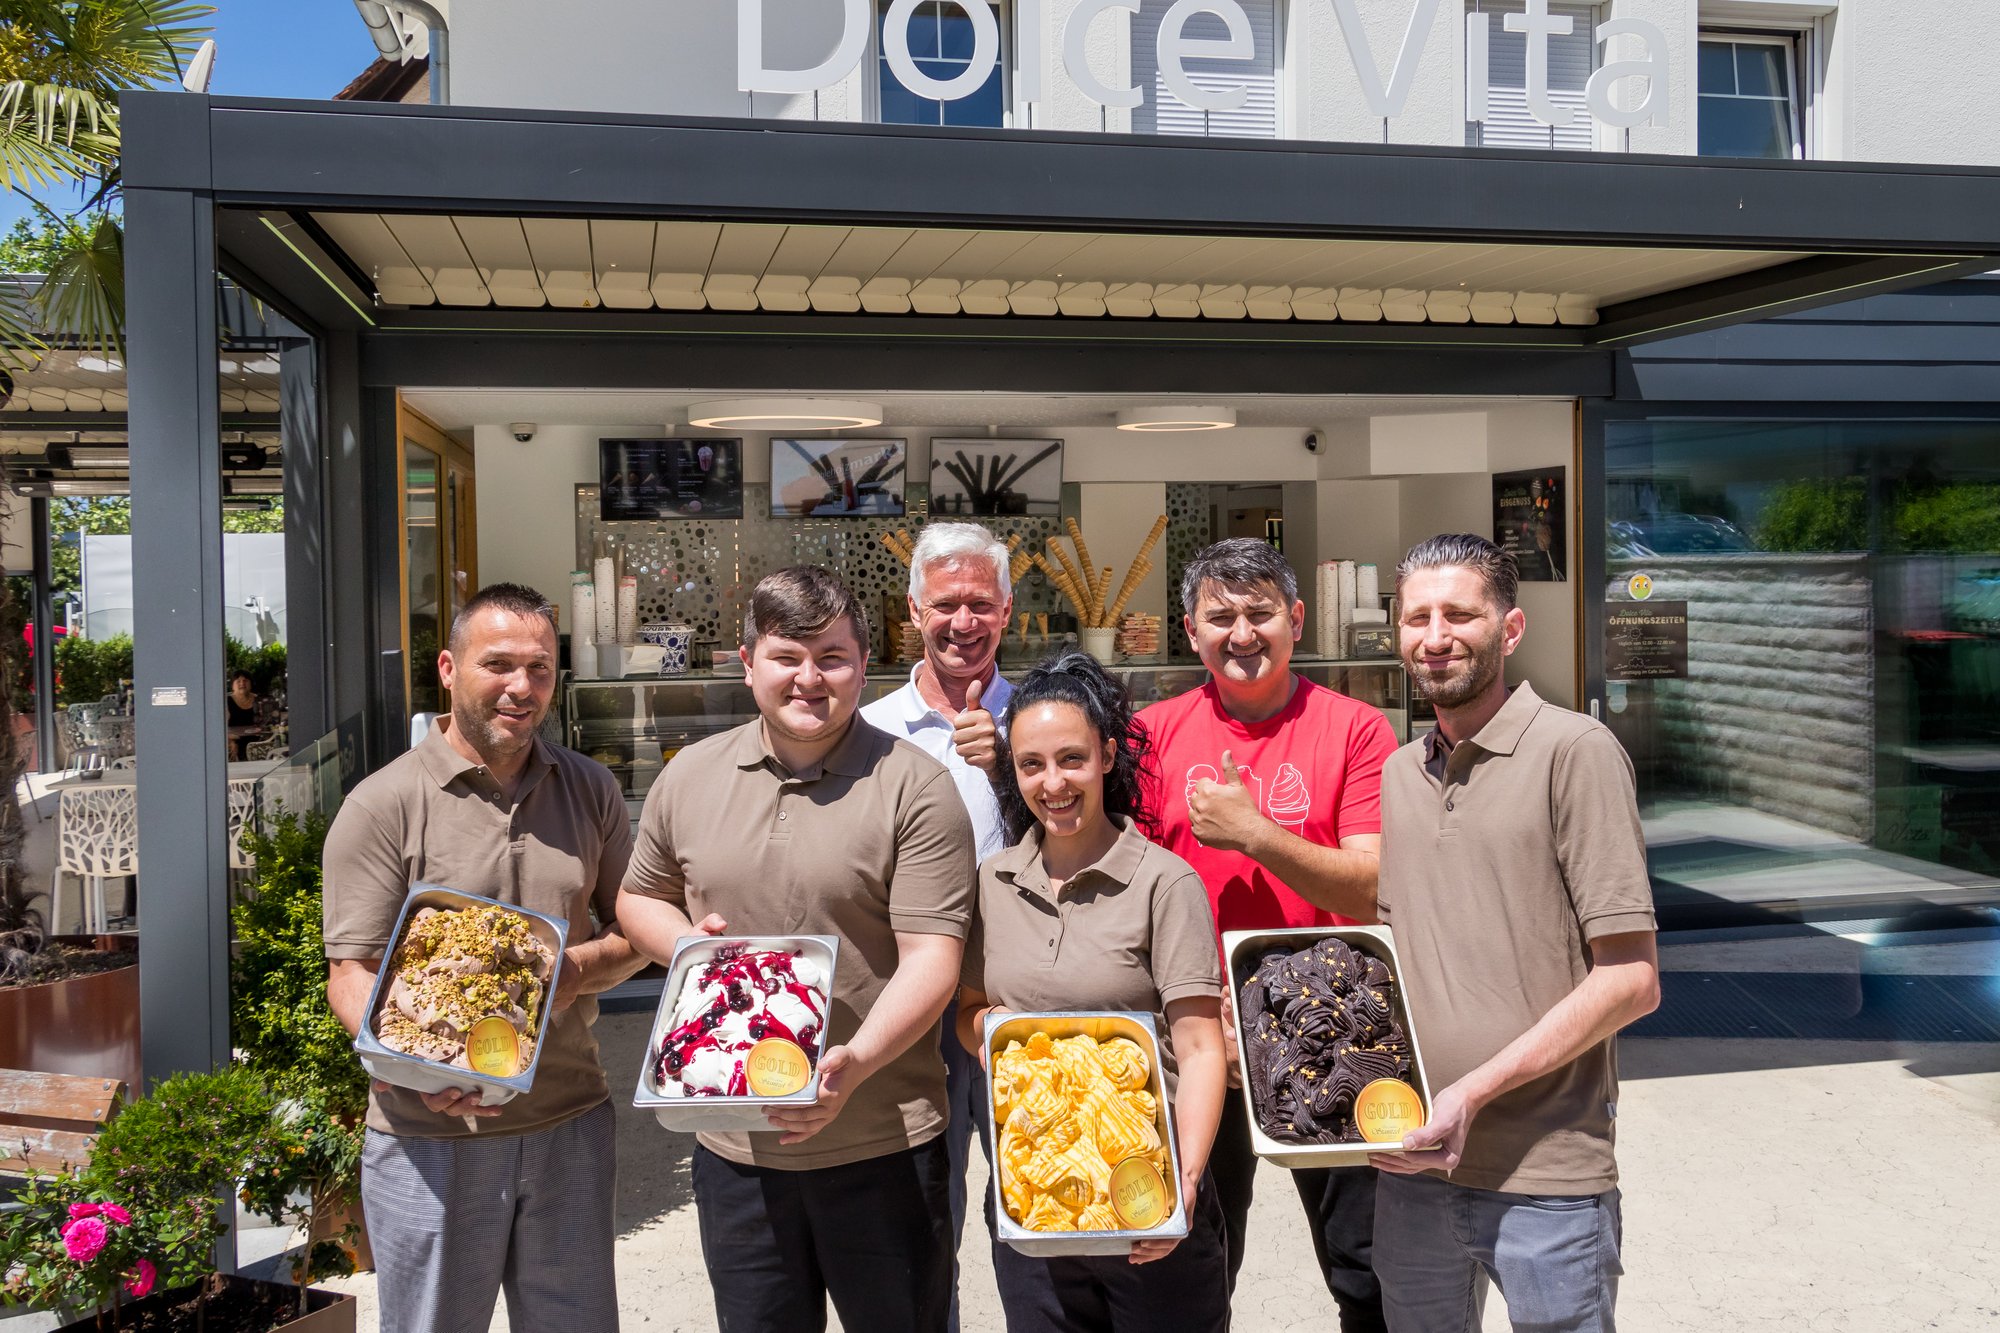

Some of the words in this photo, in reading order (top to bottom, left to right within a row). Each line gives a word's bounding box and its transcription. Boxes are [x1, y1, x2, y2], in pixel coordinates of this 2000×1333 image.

[737, 0, 1256, 110] Dolce
[1331, 0, 1671, 128] Vita
[1500, 497, 1531, 507] EISGENUSS
[1609, 616, 1685, 625] ÖFFNUNGSZEITEN
[473, 1036, 511, 1055] GOLD
[754, 1055, 800, 1077] GOLD
[1364, 1102, 1411, 1120] GOLD
[1117, 1173, 1155, 1207] GOLD
